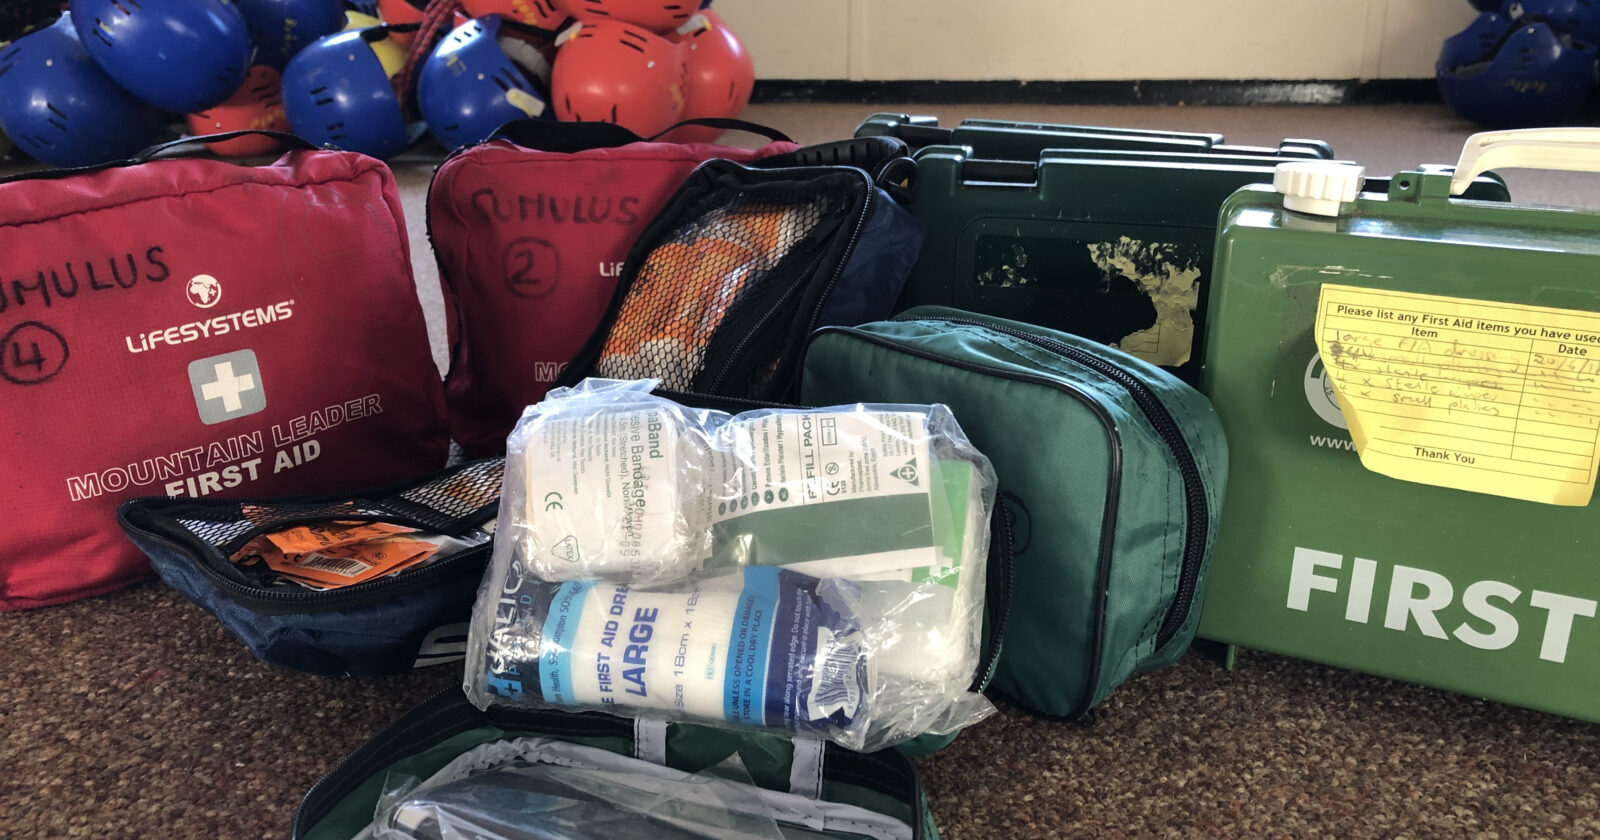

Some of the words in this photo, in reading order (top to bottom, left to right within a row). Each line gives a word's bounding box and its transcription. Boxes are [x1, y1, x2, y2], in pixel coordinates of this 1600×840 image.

[0, 246, 170, 312] MULUS
[1336, 305, 1374, 319] Please
[1376, 309, 1395, 321] list
[1397, 314, 1418, 325] any
[1422, 314, 1449, 328] First
[1453, 318, 1473, 330] Aid
[1476, 321, 1510, 334] items
[1514, 327, 1537, 337] you
[1540, 328, 1571, 341] have
[1411, 327, 1438, 339] Item
[1558, 344, 1588, 357] Date
[802, 414, 813, 446] PACK
[67, 431, 264, 502] MOUNTAIN
[272, 394, 384, 447] LEADER
[1414, 446, 1450, 461] Thank
[1454, 451, 1476, 465] You
[165, 458, 263, 499] FIRST
[273, 439, 321, 474] AID
[631, 445, 646, 507] Bandage
[805, 450, 817, 499] RFILL
[565, 539, 574, 559] LATEX
[1286, 546, 1598, 664] FIRST
[601, 620, 619, 648] AID
[739, 628, 748, 640] OR
[751, 609, 763, 632] PLACE
[622, 608, 659, 697] LARGE
[674, 633, 689, 677] 18cm
[748, 634, 758, 651] DRY
[597, 652, 613, 692] FIRST
[734, 641, 745, 677] OPENED
[746, 653, 756, 677] COOL
[786, 653, 795, 682] serrated
[674, 684, 684, 708] Size
[732, 679, 740, 709] UNLESS
[783, 683, 794, 704] along
[743, 698, 752, 720] STORE
